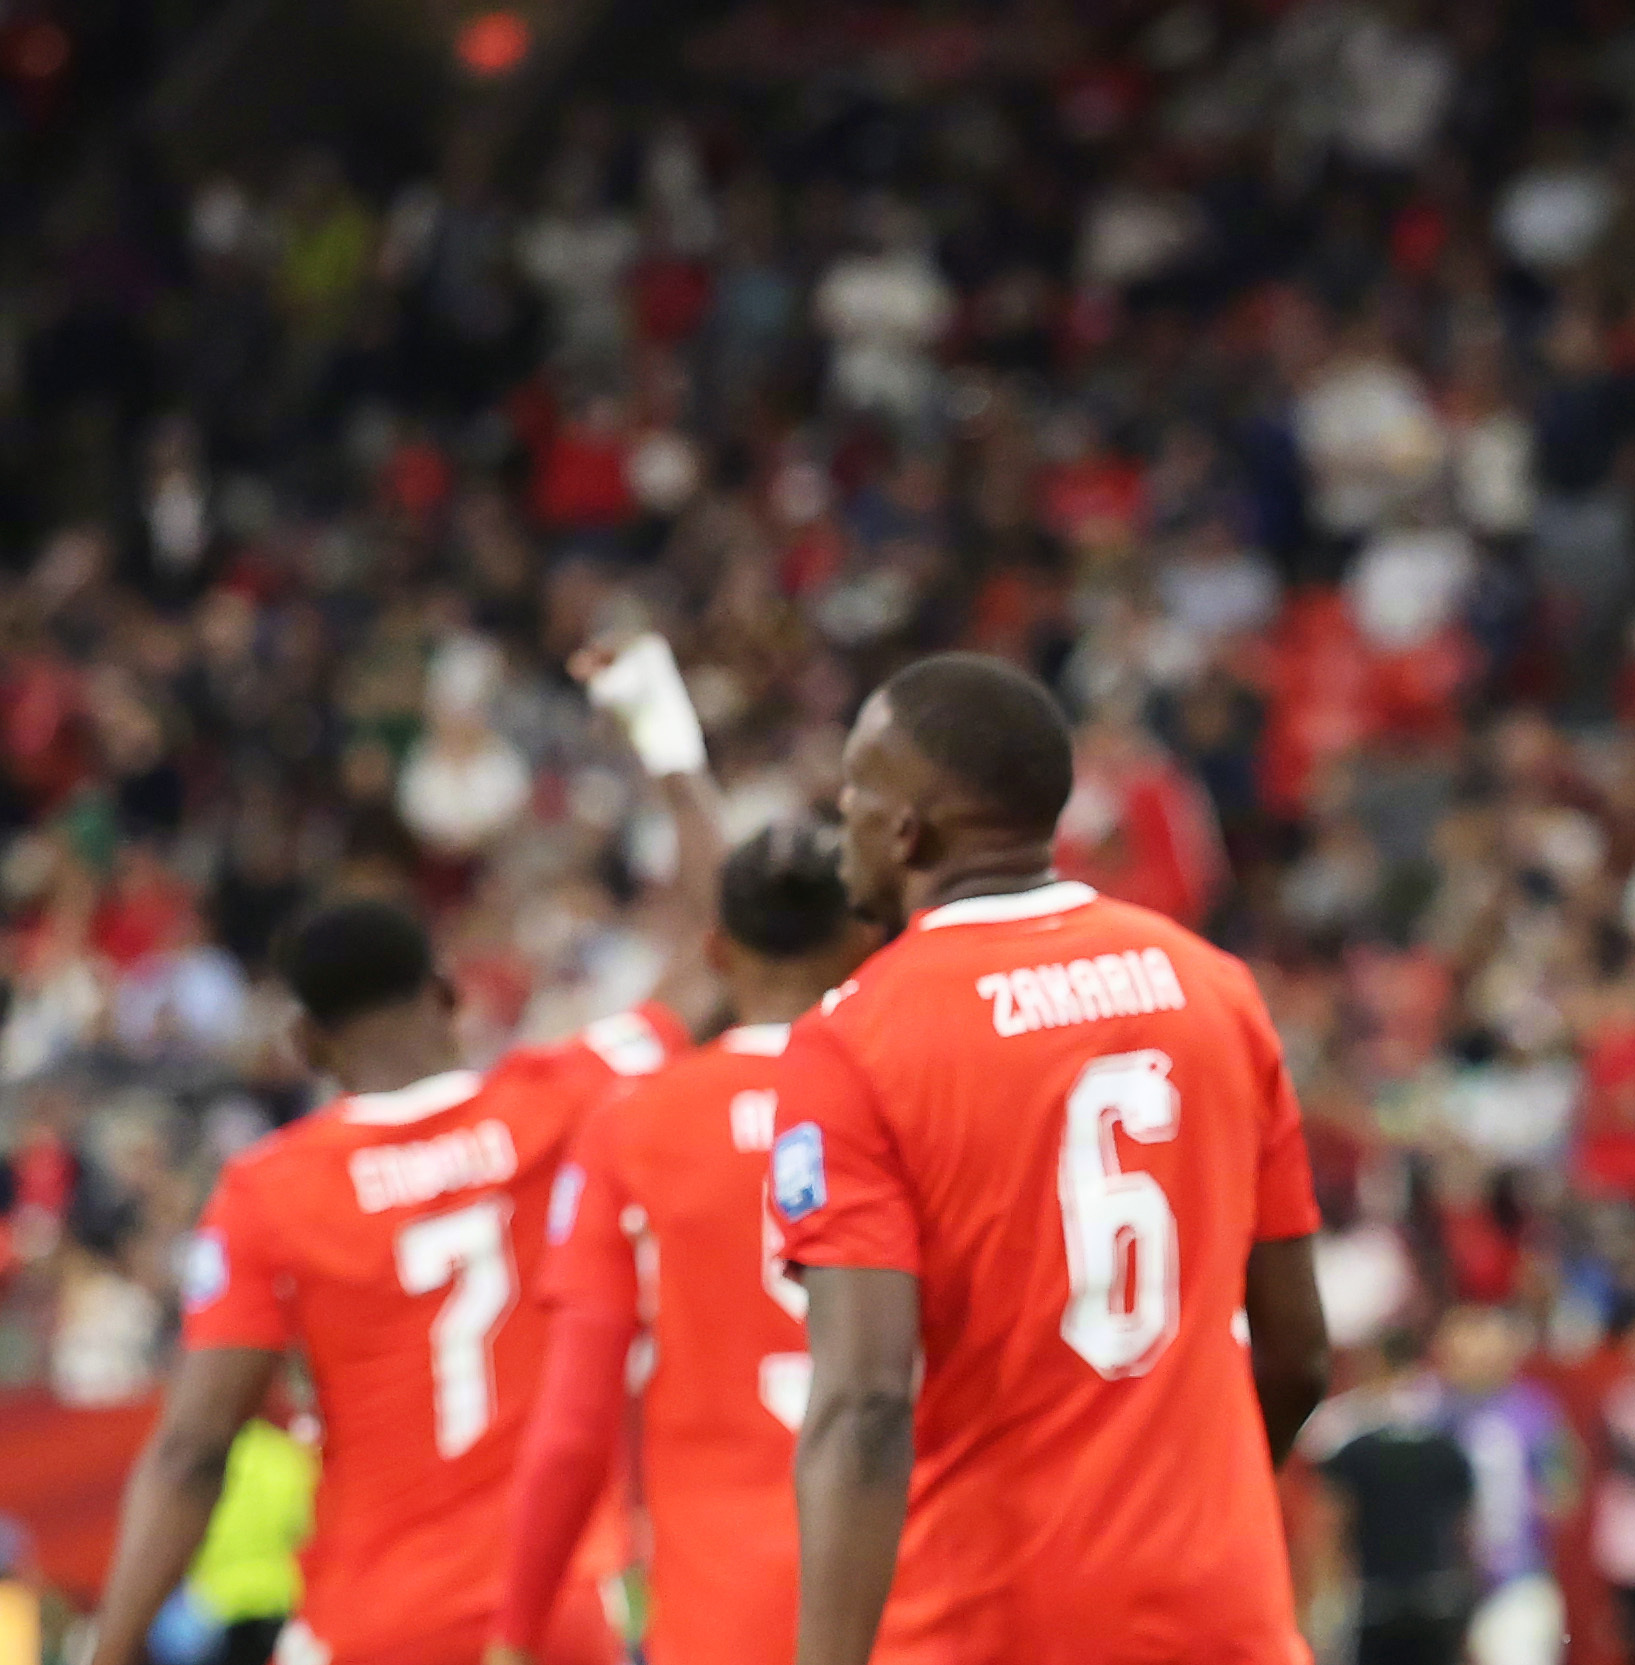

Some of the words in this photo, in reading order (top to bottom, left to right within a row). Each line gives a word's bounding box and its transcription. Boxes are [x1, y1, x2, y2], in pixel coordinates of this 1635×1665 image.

[976, 947, 1187, 1037] ZAKARIA
[395, 1194, 519, 1461] 7
[1058, 1047, 1182, 1381] 6
